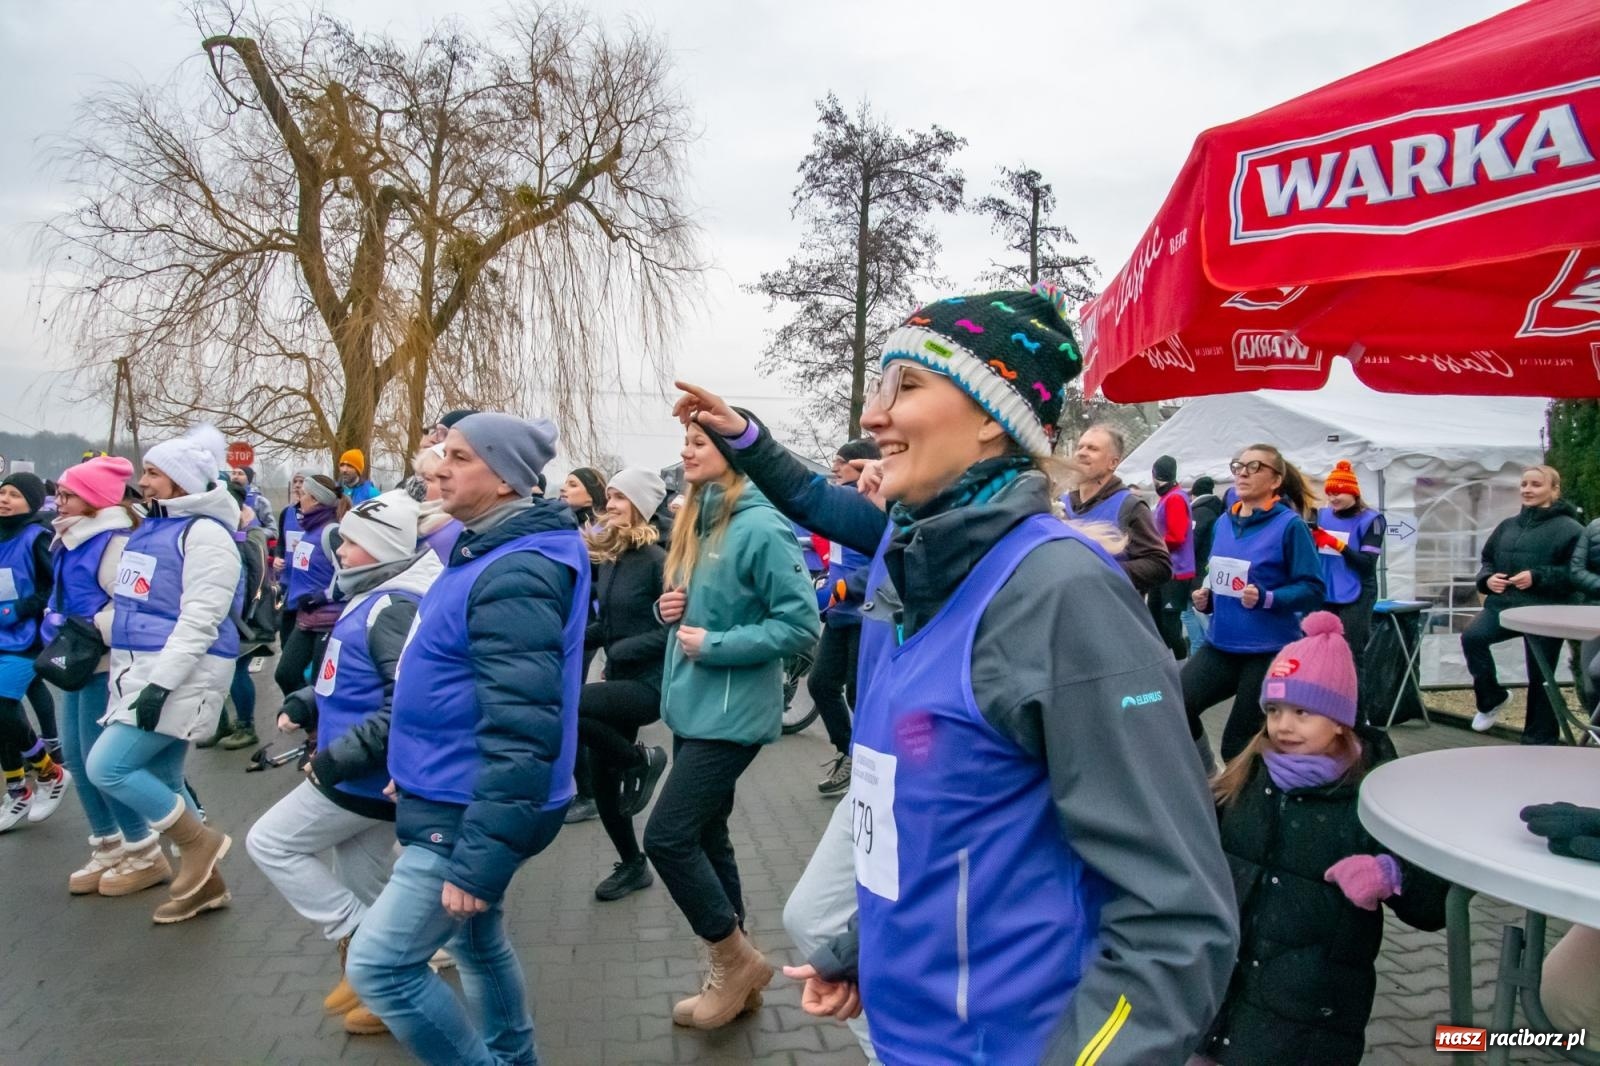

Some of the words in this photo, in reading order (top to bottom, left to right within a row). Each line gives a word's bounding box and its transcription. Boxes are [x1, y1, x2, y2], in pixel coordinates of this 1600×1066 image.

[1256, 103, 1597, 218] WARKA
[228, 451, 252, 461] STOP
[1216, 570, 1231, 587] 81
[852, 798, 874, 855] 179
